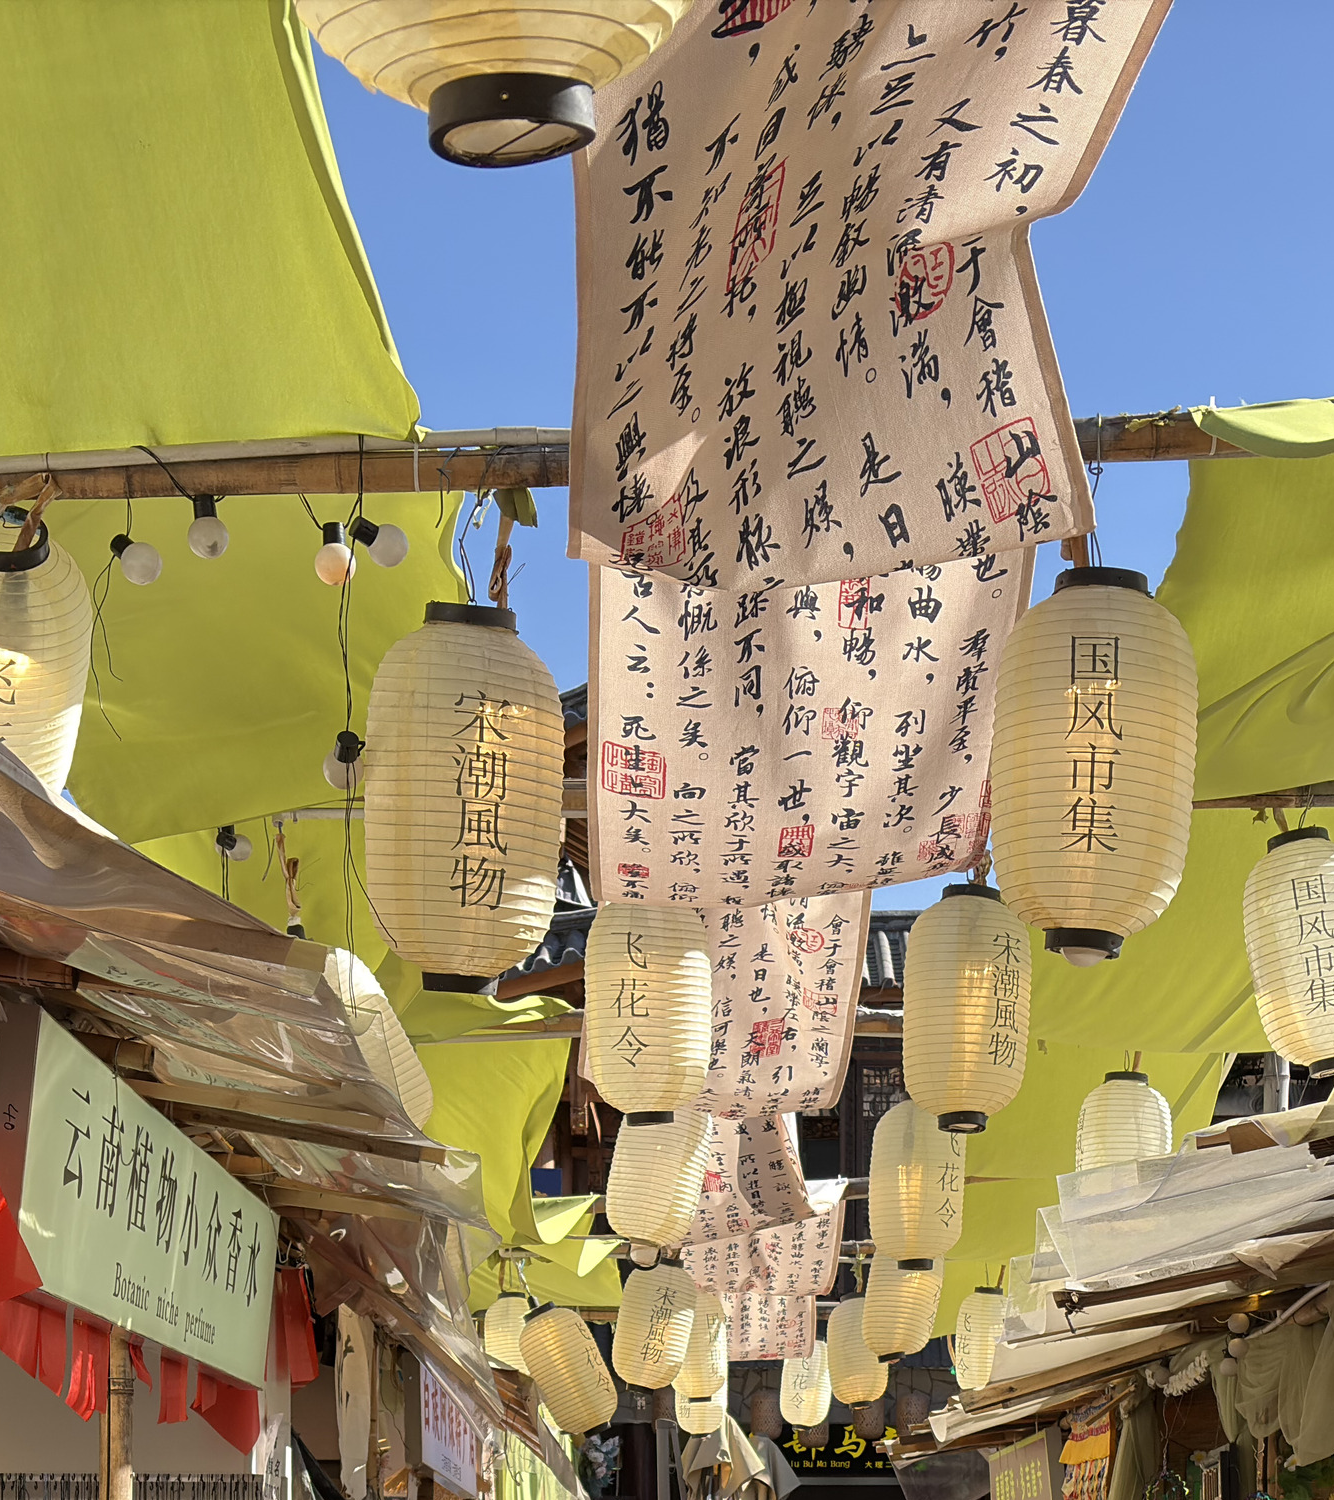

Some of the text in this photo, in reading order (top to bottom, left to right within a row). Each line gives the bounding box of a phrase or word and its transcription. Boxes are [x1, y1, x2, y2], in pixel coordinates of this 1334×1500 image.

[449, 689, 511, 913] 宋潮風物
[1059, 634, 1124, 854] 国风市集
[609, 930, 651, 1069] 飞花令
[986, 930, 1023, 1071] 宋潮風物
[63, 1086, 260, 1307] 云南植物小众香水
[113, 1261, 216, 1346] Botanic niche perfume
[830, 1460, 851, 1469] Bang
